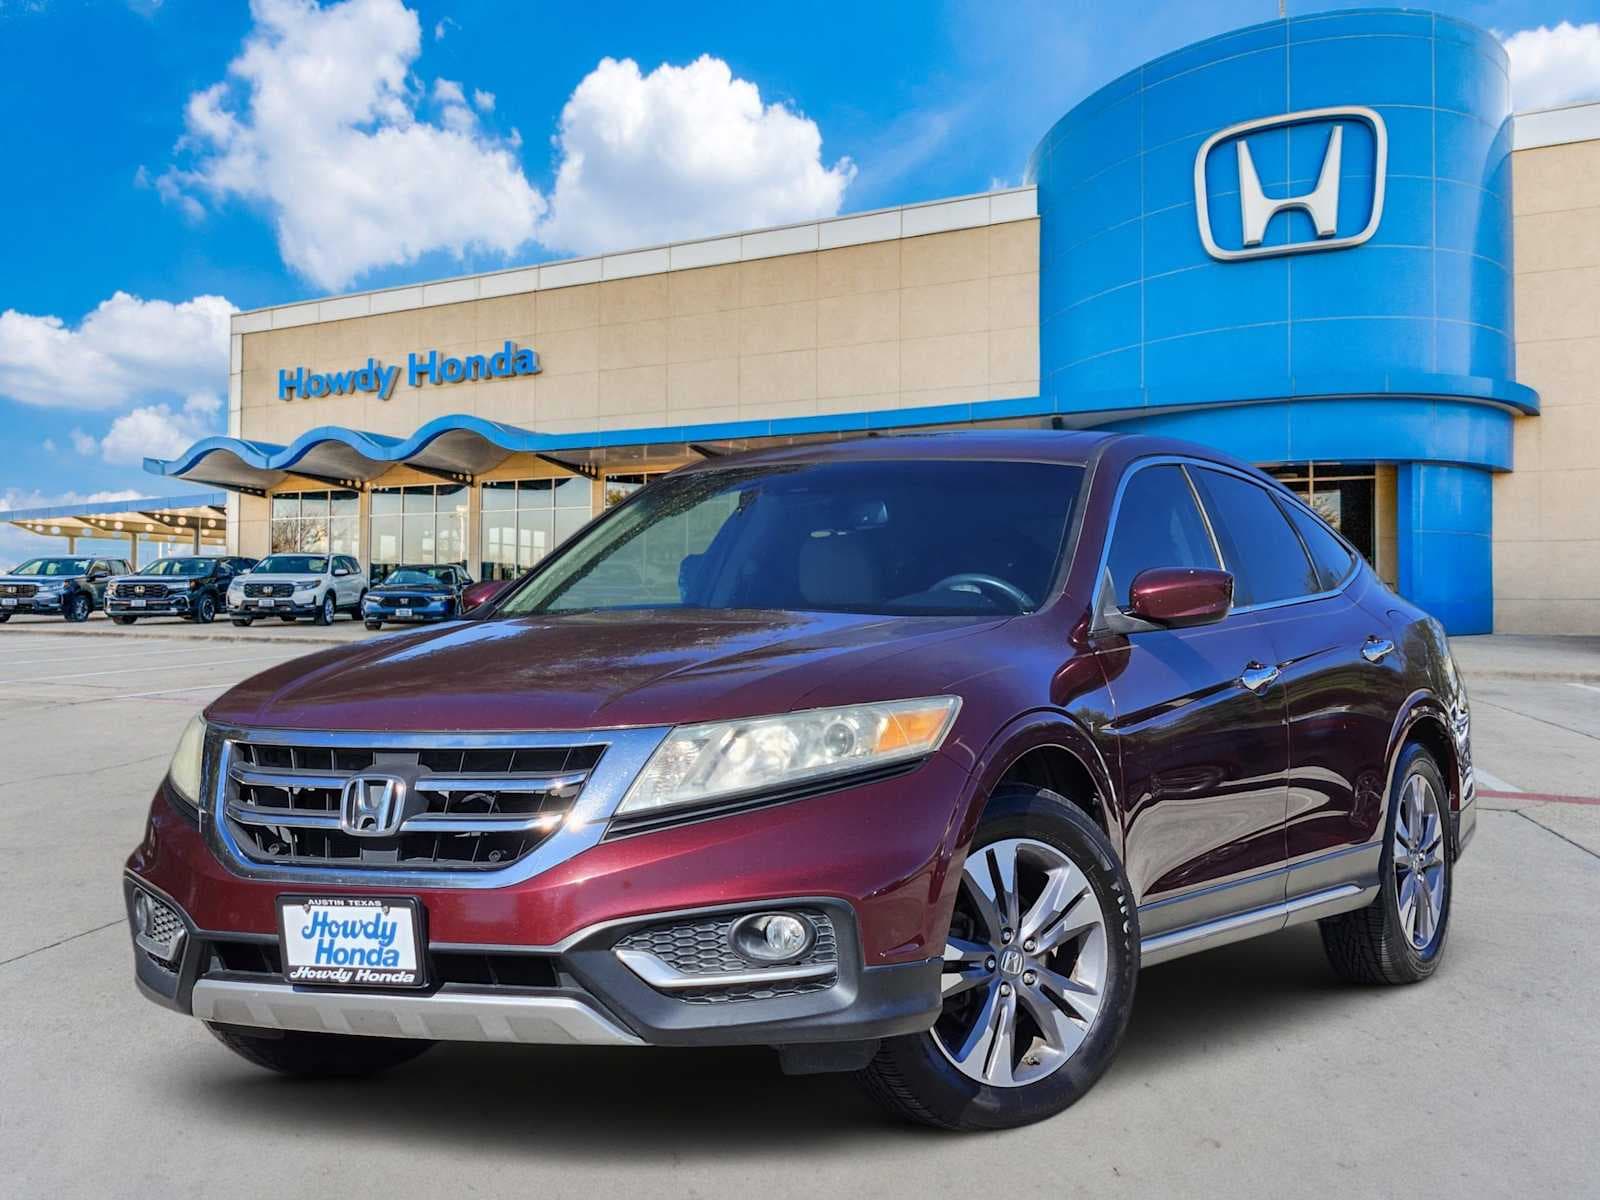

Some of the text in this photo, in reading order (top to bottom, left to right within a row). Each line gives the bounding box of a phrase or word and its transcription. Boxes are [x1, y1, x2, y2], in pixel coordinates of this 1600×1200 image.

[278, 341, 542, 400] Howdy Honda
[308, 898, 382, 907] AUSTIN TEXAS
[301, 911, 398, 947] Howdy
[315, 939, 399, 967] Honda
[290, 966, 416, 983] Howdy Honda
